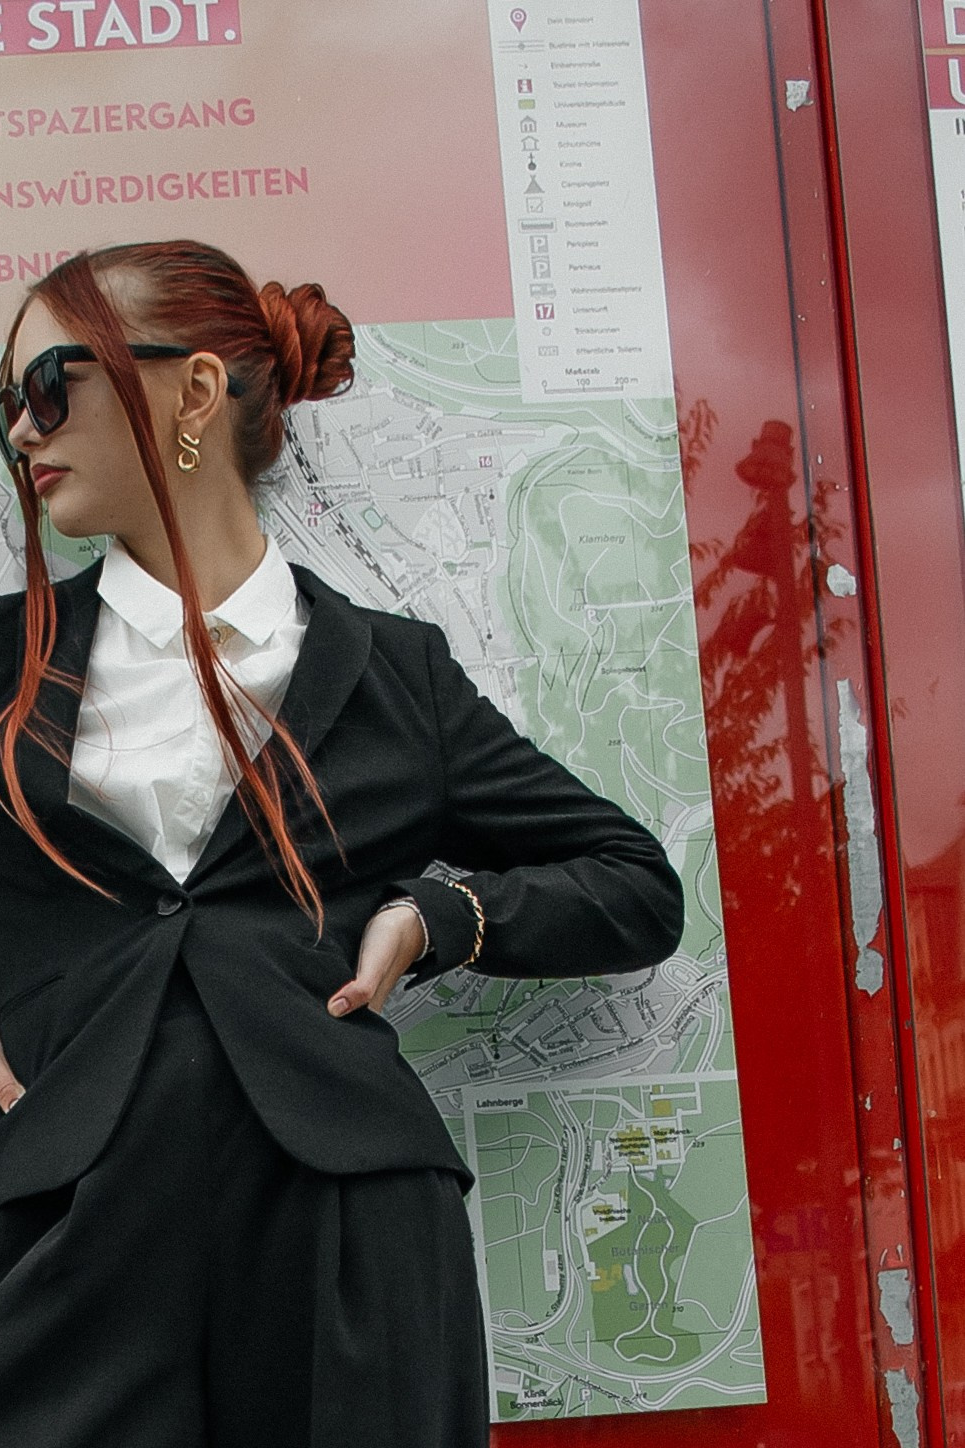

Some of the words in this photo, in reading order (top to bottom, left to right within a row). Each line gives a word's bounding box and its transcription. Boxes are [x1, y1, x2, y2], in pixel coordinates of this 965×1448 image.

[27, 0, 236, 50] STADT.
[537, 304, 552, 318] 17
[579, 534, 626, 544] Klamberg
[476, 1099, 524, 1109] Lahnberge
